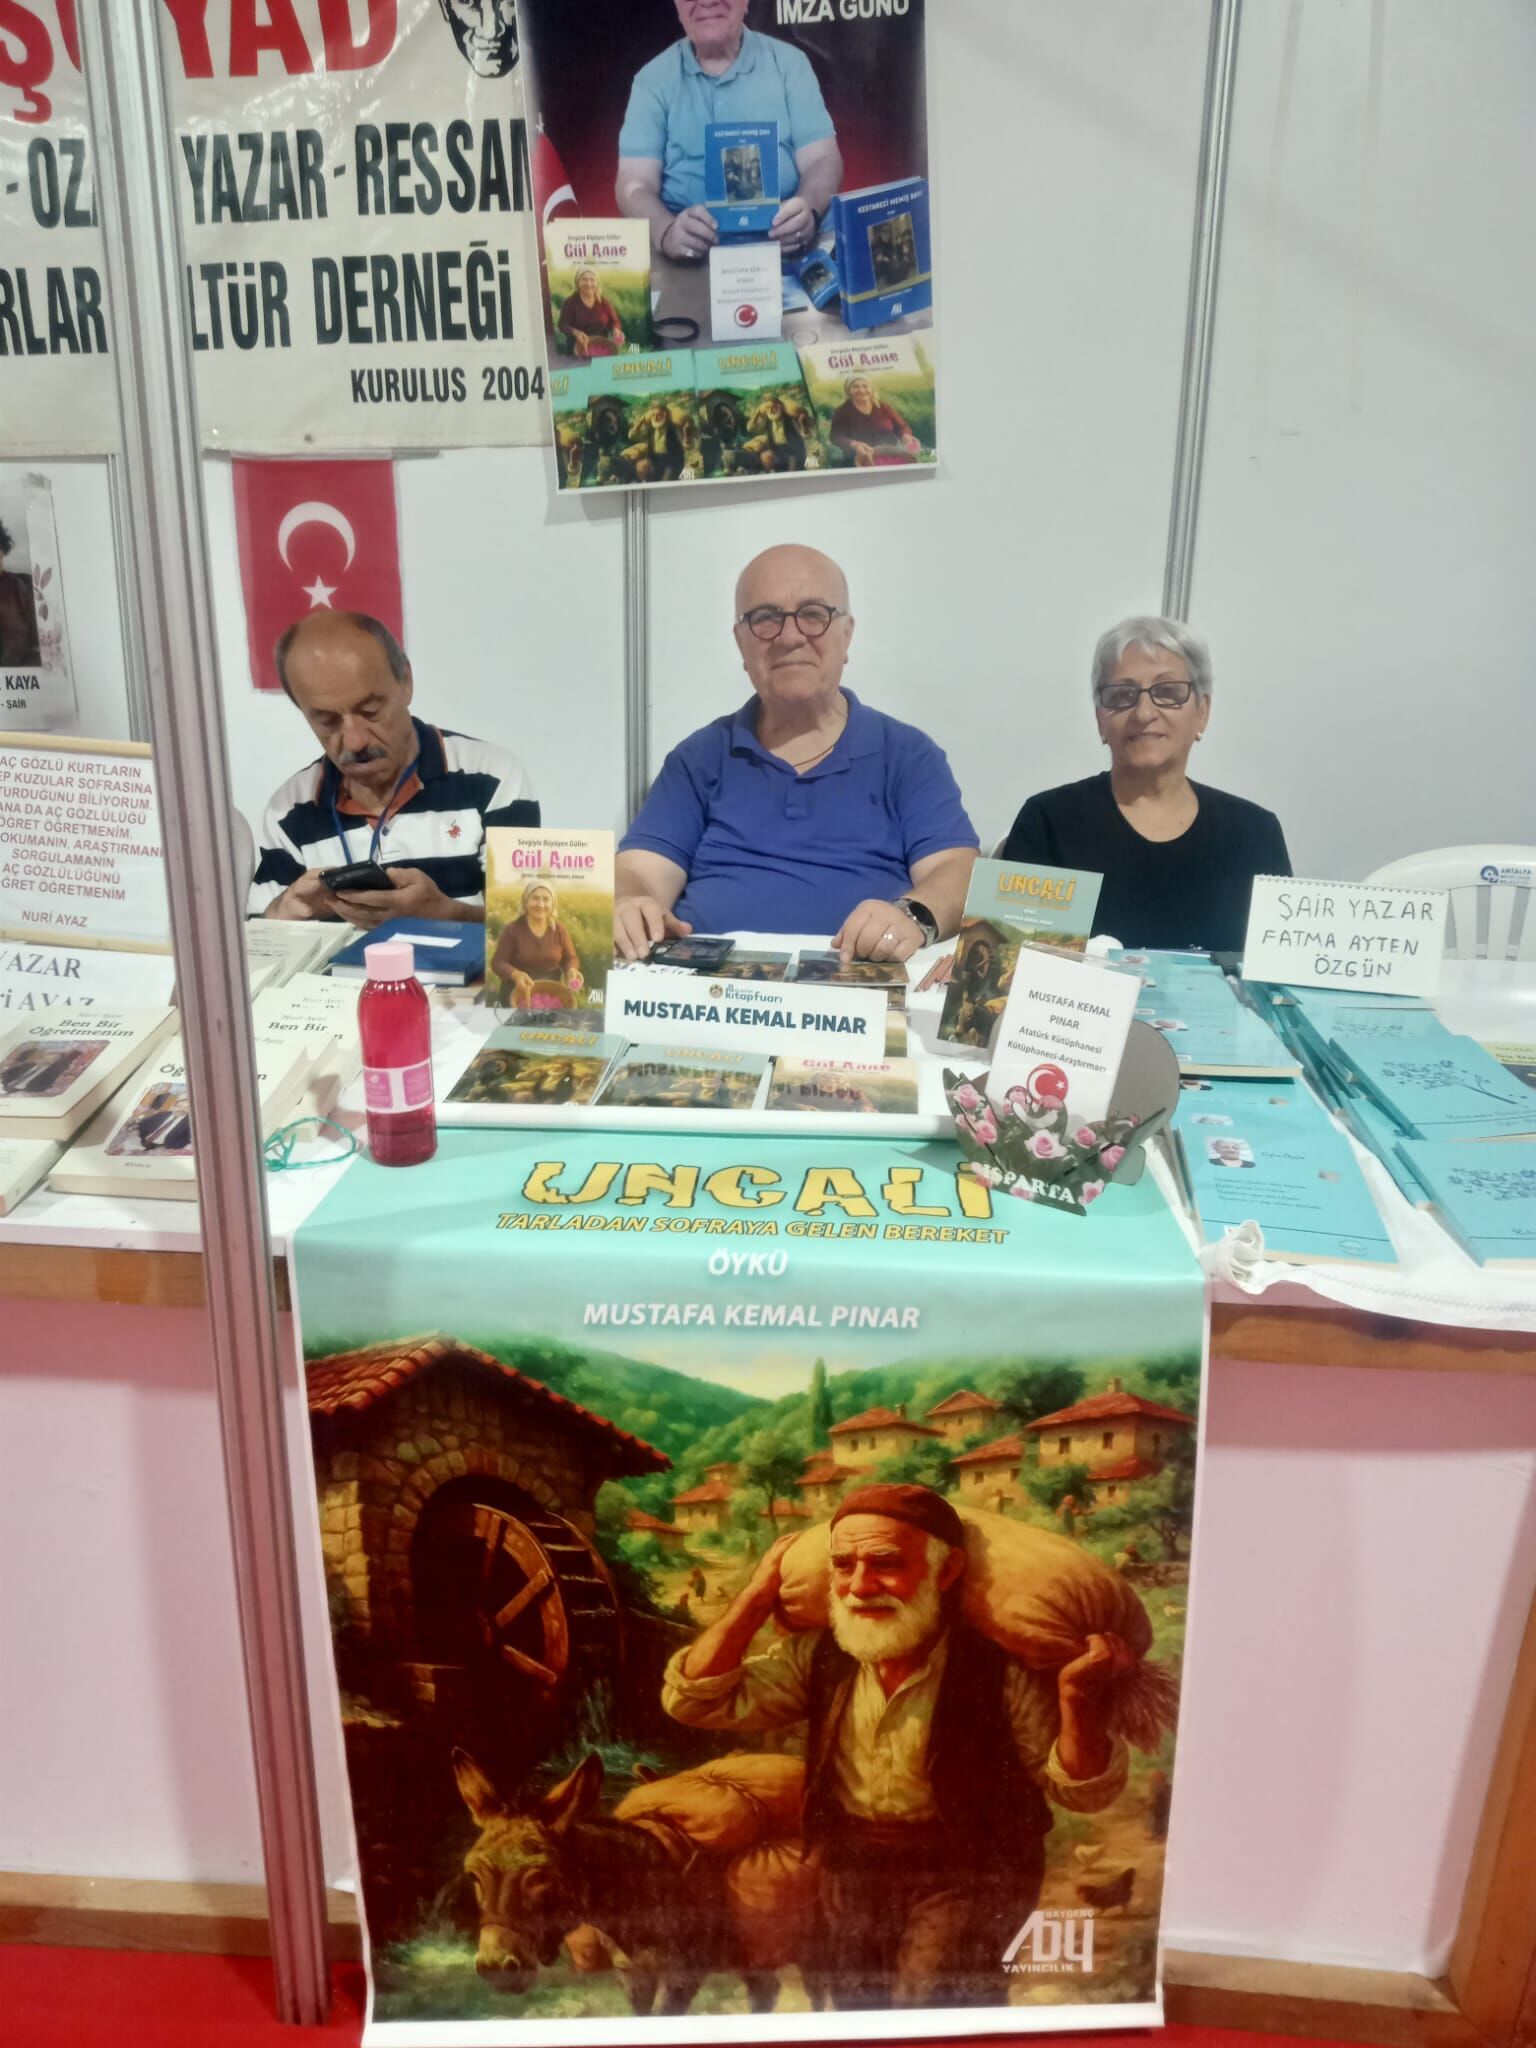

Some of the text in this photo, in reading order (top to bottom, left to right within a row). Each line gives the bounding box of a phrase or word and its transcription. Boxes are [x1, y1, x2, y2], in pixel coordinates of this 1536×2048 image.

[6, 137, 98, 229] -OZ
[564, 243, 627, 258] Gül Anne
[828, 351, 899, 369] Gül Anne
[350, 366, 467, 403] KURULUS
[482, 366, 545, 401] 2004
[5, 675, 40, 690] KAYA
[68, 761, 141, 778] KURTLARIN
[14, 772, 74, 788] KUZULAR
[78, 779, 152, 795] SOFRASINA
[25, 803, 42, 816] DA
[12, 848, 115, 868] SORGULAMANIN
[511, 849, 595, 869] Gül Anne
[2, 863, 20, 877] AÇ
[38, 880, 126, 901] ÖĞRETMENİM
[1278, 891, 1434, 921] ŞAİR YAZAR
[22, 910, 88, 928] NURİ AYAZ
[1262, 929, 1419, 956] FATMA AYTEN
[1314, 953, 1392, 978] ÖZGÜN
[1028, 989, 1111, 1018] MUSTAFA KEMAL
[58, 1019, 122, 1029] Ben Bir
[268, 1022, 328, 1032] Ben Bir
[624, 999, 867, 1035] MUSTAFA KEMAL PINAR
[1049, 1014, 1080, 1030] PINAR
[29, 1026, 134, 1038] Öğretmenim
[1019, 1026, 1103, 1054] Atatürk Kütüphanesi
[521, 1160, 994, 1220] UNCALİ
[496, 1212, 1010, 1244] TARLADAN SOFRAYA GELEN BEREKET
[708, 1246, 789, 1277] ÖYKÜ
[583, 1302, 920, 1330] MUSTAFA KEMAL PINAR
[1002, 1963, 1074, 1973] YAYINCILIK
